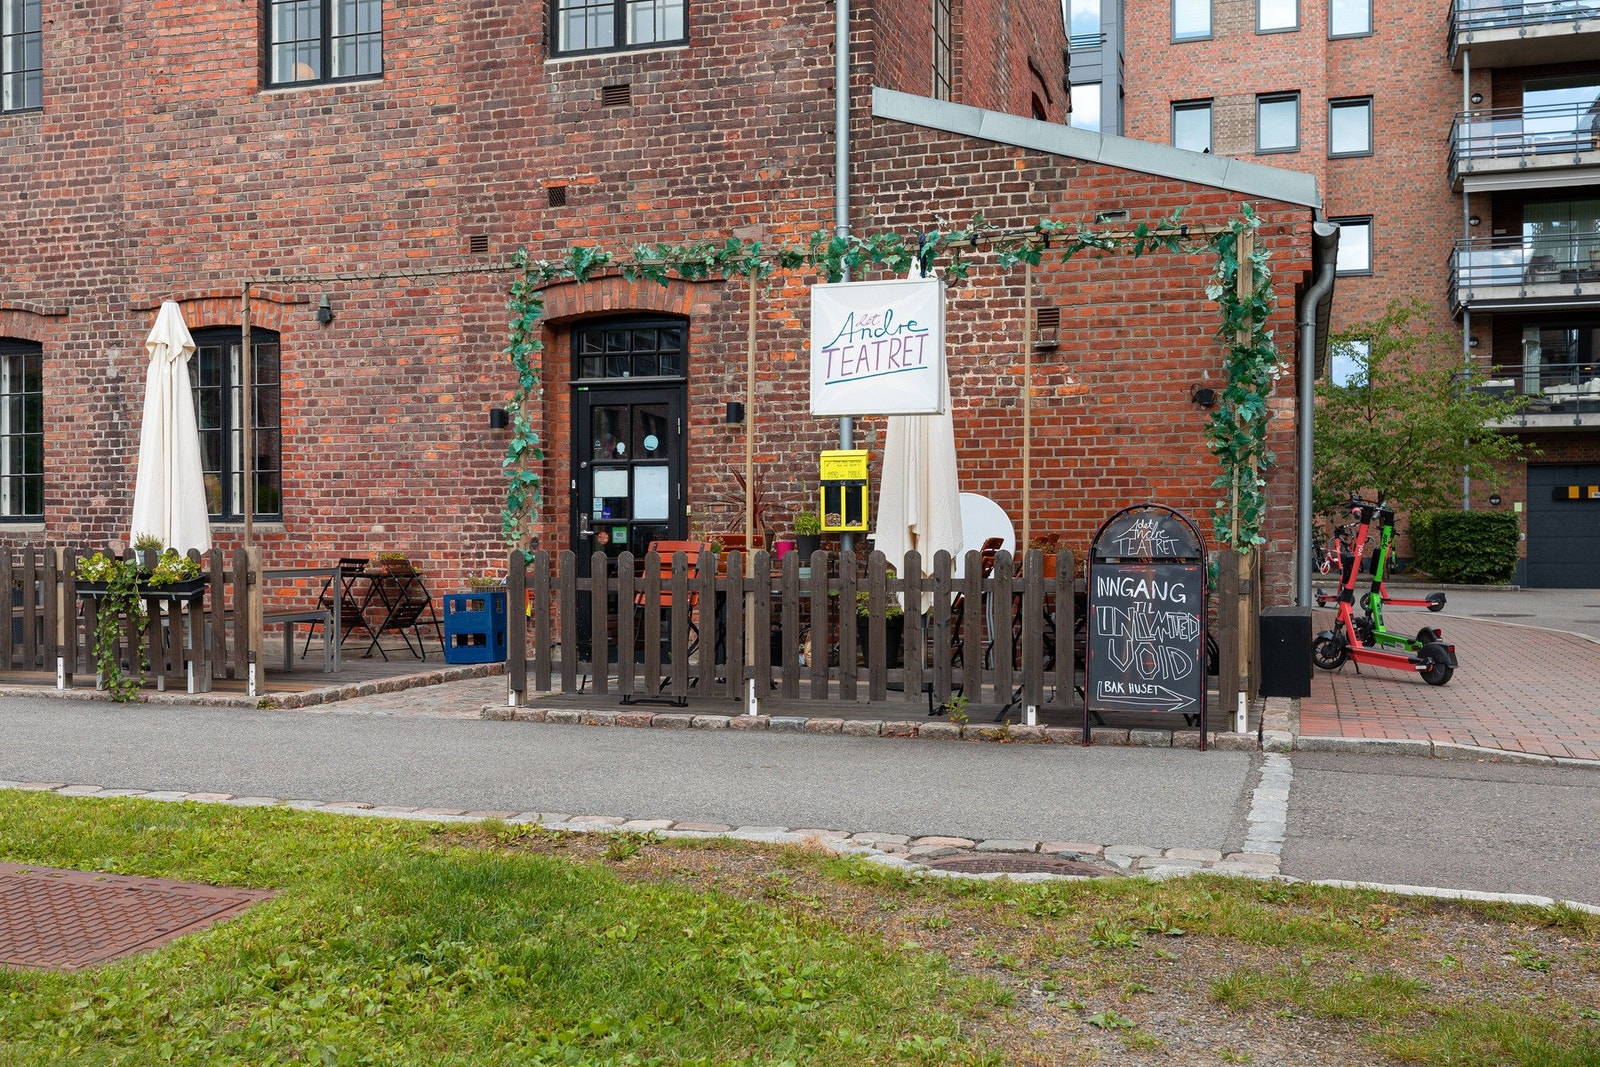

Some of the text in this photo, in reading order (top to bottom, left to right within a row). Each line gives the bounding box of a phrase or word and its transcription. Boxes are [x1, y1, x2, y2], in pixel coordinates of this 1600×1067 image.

[822, 308, 929, 350] Andre
[821, 333, 929, 379] TEATRET
[1116, 518, 1170, 540] Andre
[1112, 536, 1180, 556] TEATRET
[1097, 575, 1187, 604] INNGANG
[1133, 601, 1155, 614] TIL
[1107, 638, 1193, 681] VOID
[1104, 681, 1159, 695] BAK HUSET
